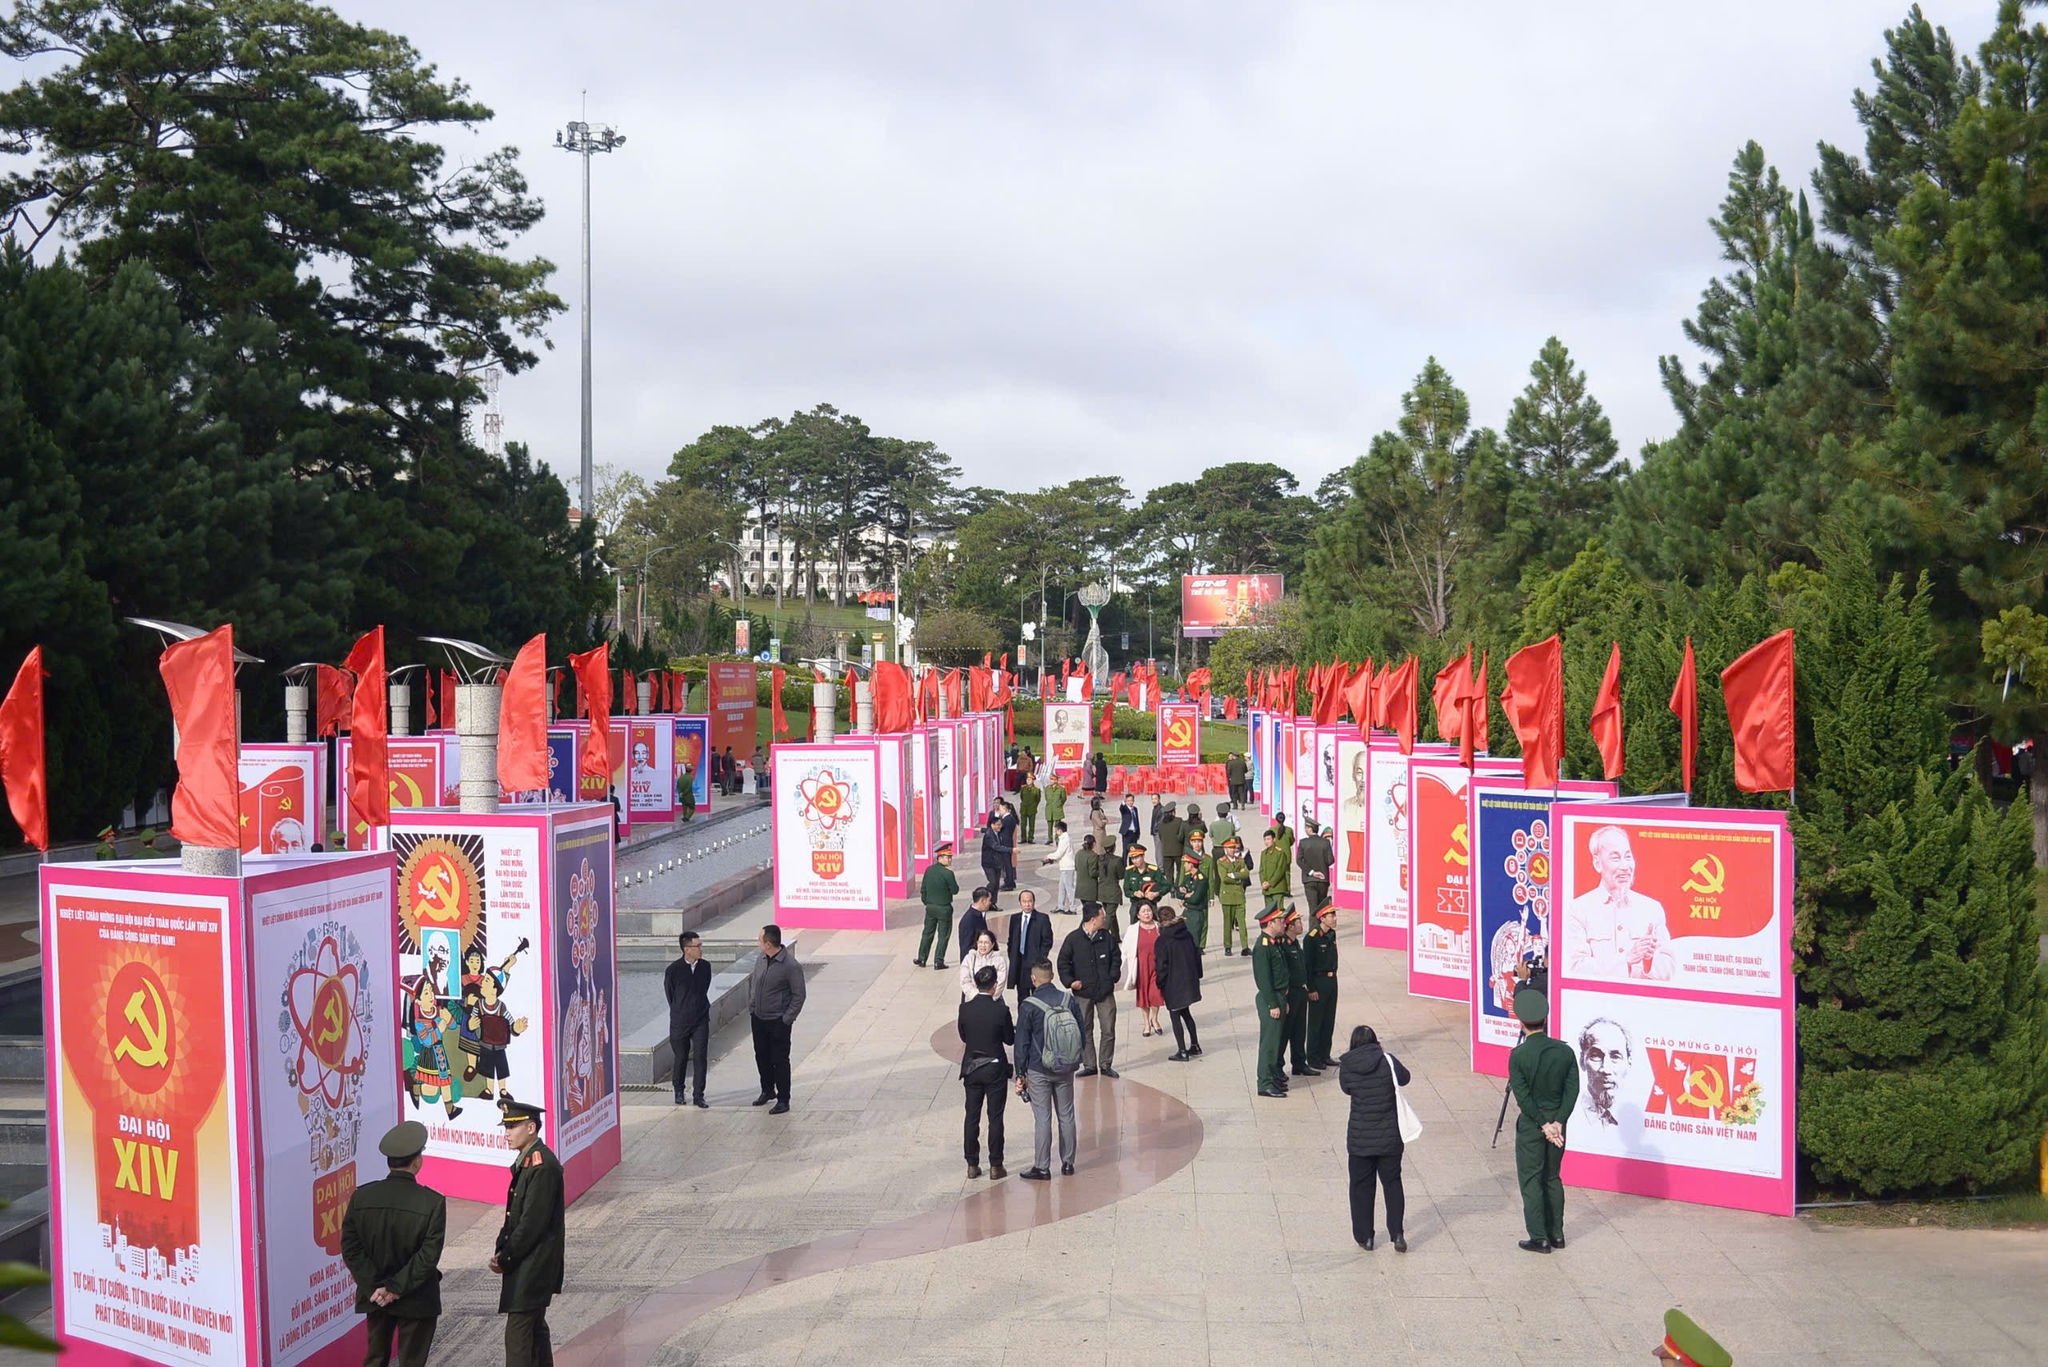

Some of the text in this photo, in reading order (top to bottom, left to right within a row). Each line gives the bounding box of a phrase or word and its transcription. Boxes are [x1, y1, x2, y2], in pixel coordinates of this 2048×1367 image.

[581, 778, 606, 789] XIV
[632, 785, 650, 793] XIV
[816, 863, 841, 872] XIV
[60, 908, 74, 922] NHIỆT
[75, 909, 85, 922] LIỆT
[86, 910, 100, 921] CHÀO
[100, 910, 114, 923] MỪNG
[115, 913, 124, 926] ĐẠI
[125, 914, 133, 927] HỘI
[134, 915, 143, 927] ĐẠI
[144, 913, 155, 928] BIỂU
[156, 917, 169, 929] TOÀN
[170, 916, 184, 931] QUỐC
[185, 917, 196, 932] LẦN
[196, 920, 207, 932] THỨ
[1689, 905, 1721, 920] XIV
[99, 925, 110, 939] CỦA
[111, 926, 124, 941] ĐẢNG
[125, 931, 139, 944] CỘNG
[139, 930, 150, 942] SẢN
[150, 933, 161, 945] VIỆT
[1644, 1037, 1758, 1056] CHÀO MỪNG ĐẠI HỘI
[119, 1114, 171, 1143] ĐẠI HỘI
[451, 1129, 463, 1144] NON
[1644, 1117, 1757, 1141] ĐẢNG CỘNG SẢN VIỆT NAM
[112, 1137, 179, 1201] XIV
[316, 1172, 355, 1205] ĐẠI HỘI
[73, 1272, 81, 1293] TỰ
[82, 1269, 98, 1297] CHỦ,
[98, 1278, 107, 1300] TỰ
[131, 1287, 140, 1309] TỰ
[141, 1289, 150, 1310] TIN
[151, 1290, 168, 1314] BƯỚC
[169, 1298, 182, 1319] VÀO
[183, 1296, 191, 1320] KỶ
[192, 1307, 217, 1330] NGUYÊN
[219, 1310, 233, 1334] MỚI
[95, 1302, 211, 1356] PHÁT TRIỂN GIÀU MẠNH, THỊNH VƯỢNG!
